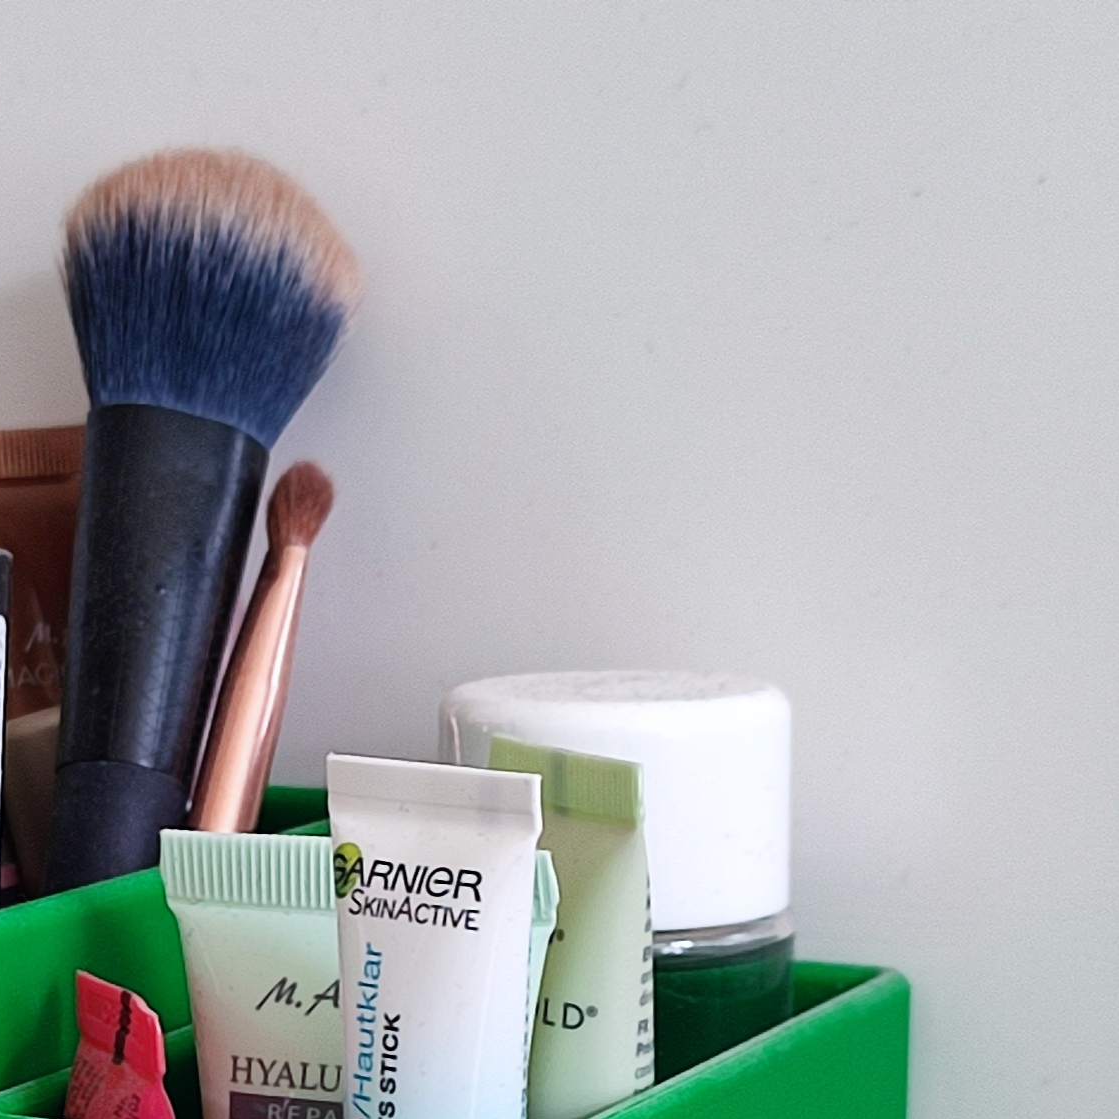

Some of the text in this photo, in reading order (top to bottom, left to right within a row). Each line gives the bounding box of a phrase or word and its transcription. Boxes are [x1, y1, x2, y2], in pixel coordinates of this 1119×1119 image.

[333, 853, 483, 903] GARNIER
[229, 1054, 343, 1093] HYALU
[378, 1011, 402, 1096] STICK
